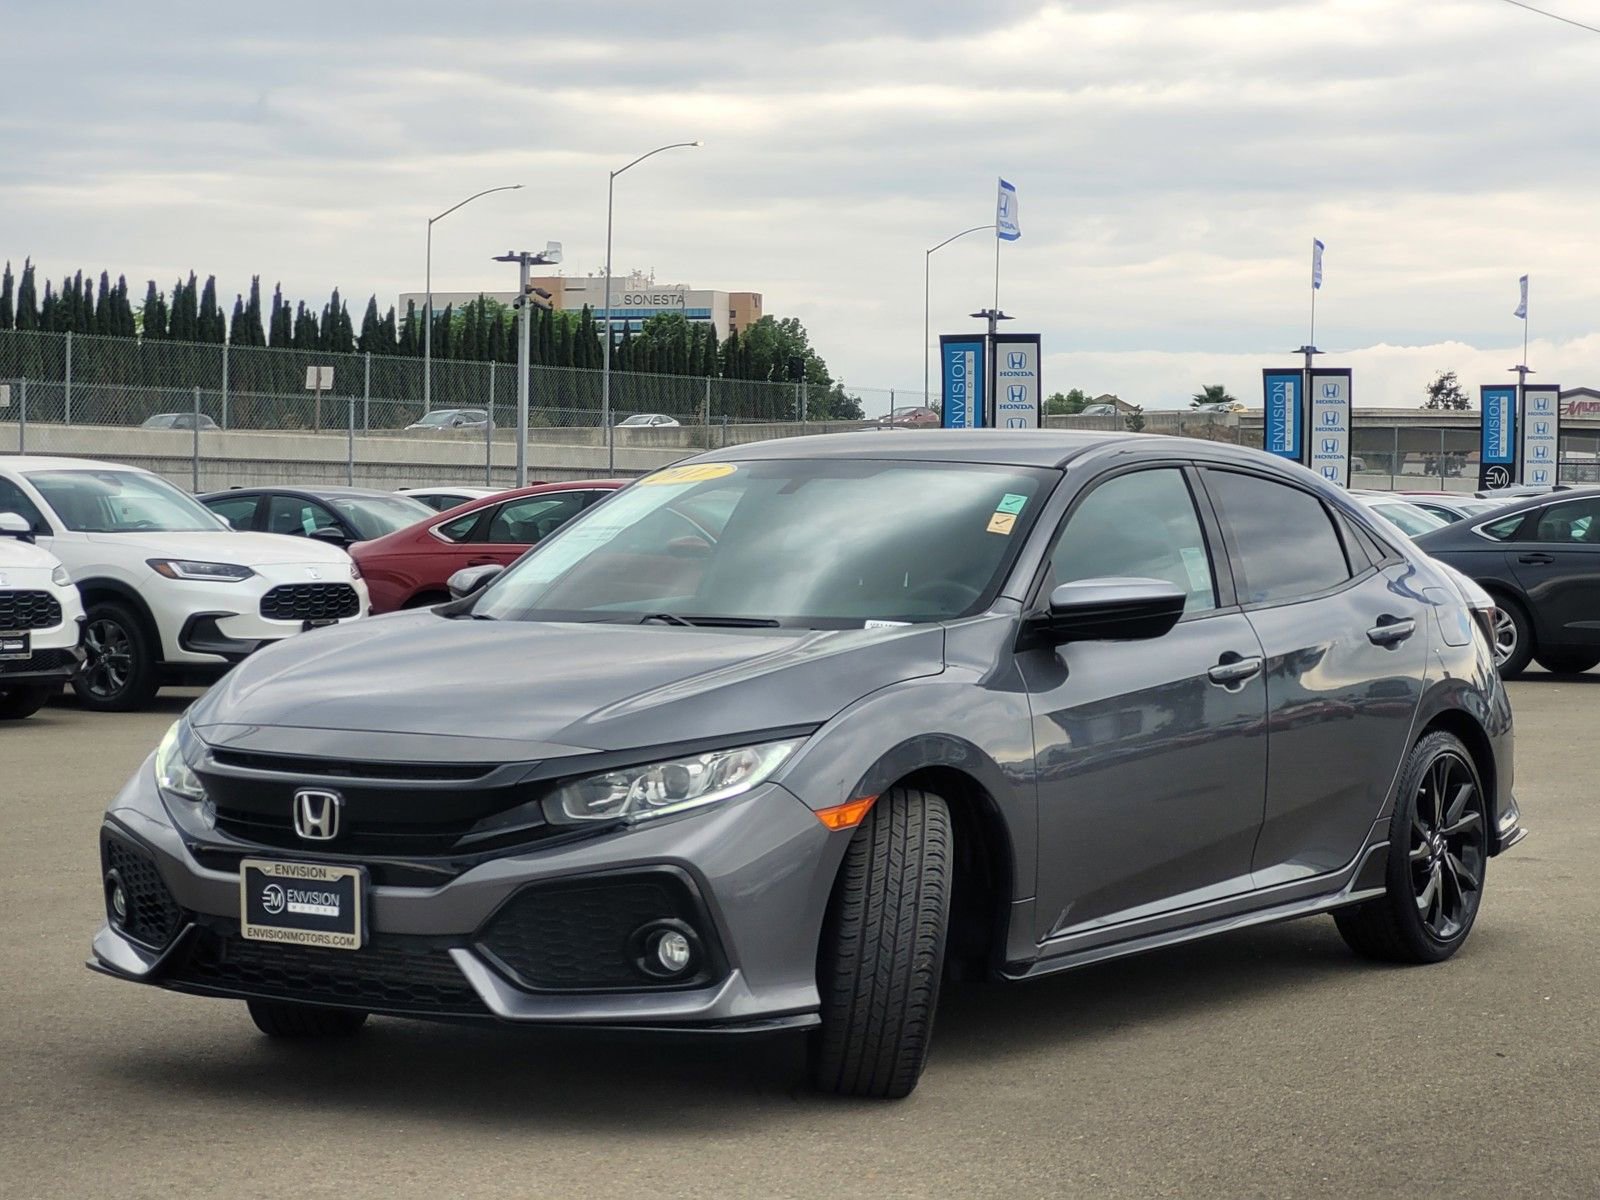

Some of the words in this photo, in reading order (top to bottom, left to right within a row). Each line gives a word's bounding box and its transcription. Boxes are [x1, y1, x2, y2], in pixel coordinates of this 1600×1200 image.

[624, 294, 684, 306] SONESTA
[1273, 382, 1285, 452] ENVISION
[1489, 396, 1500, 458] ENVISION
[275, 864, 327, 879] ENVISION
[287, 889, 340, 906] ENVISION
[292, 904, 336, 914] MOTORS
[247, 927, 356, 947] ENVISIONMOTORS.COM
